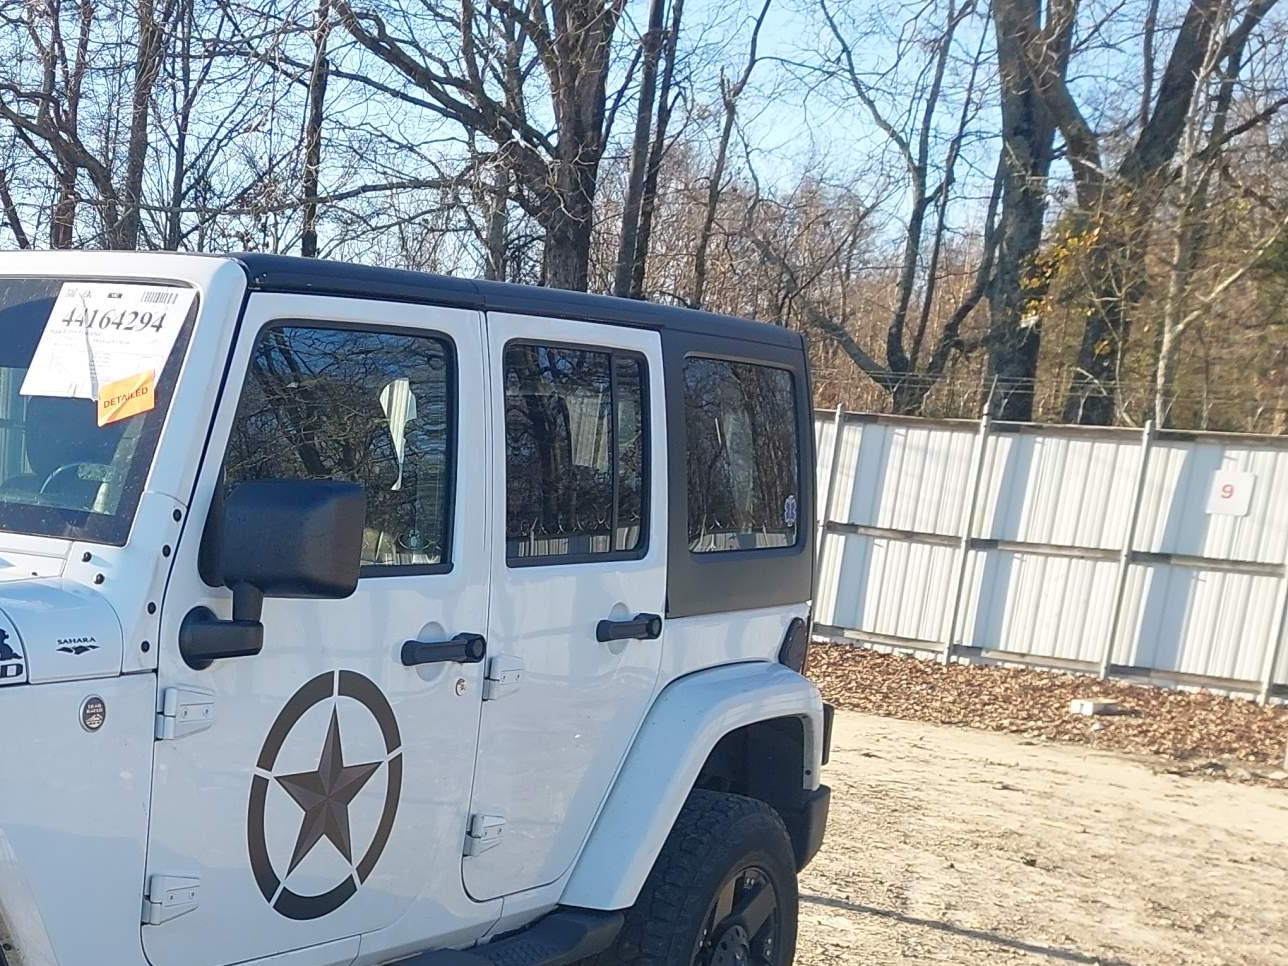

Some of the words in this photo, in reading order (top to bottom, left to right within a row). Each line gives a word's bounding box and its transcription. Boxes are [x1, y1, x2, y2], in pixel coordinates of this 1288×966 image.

[62, 307, 167, 333] 44164294
[103, 386, 148, 409] DETAILED
[1220, 484, 1235, 499] 9
[57, 637, 97, 645] SAHARA
